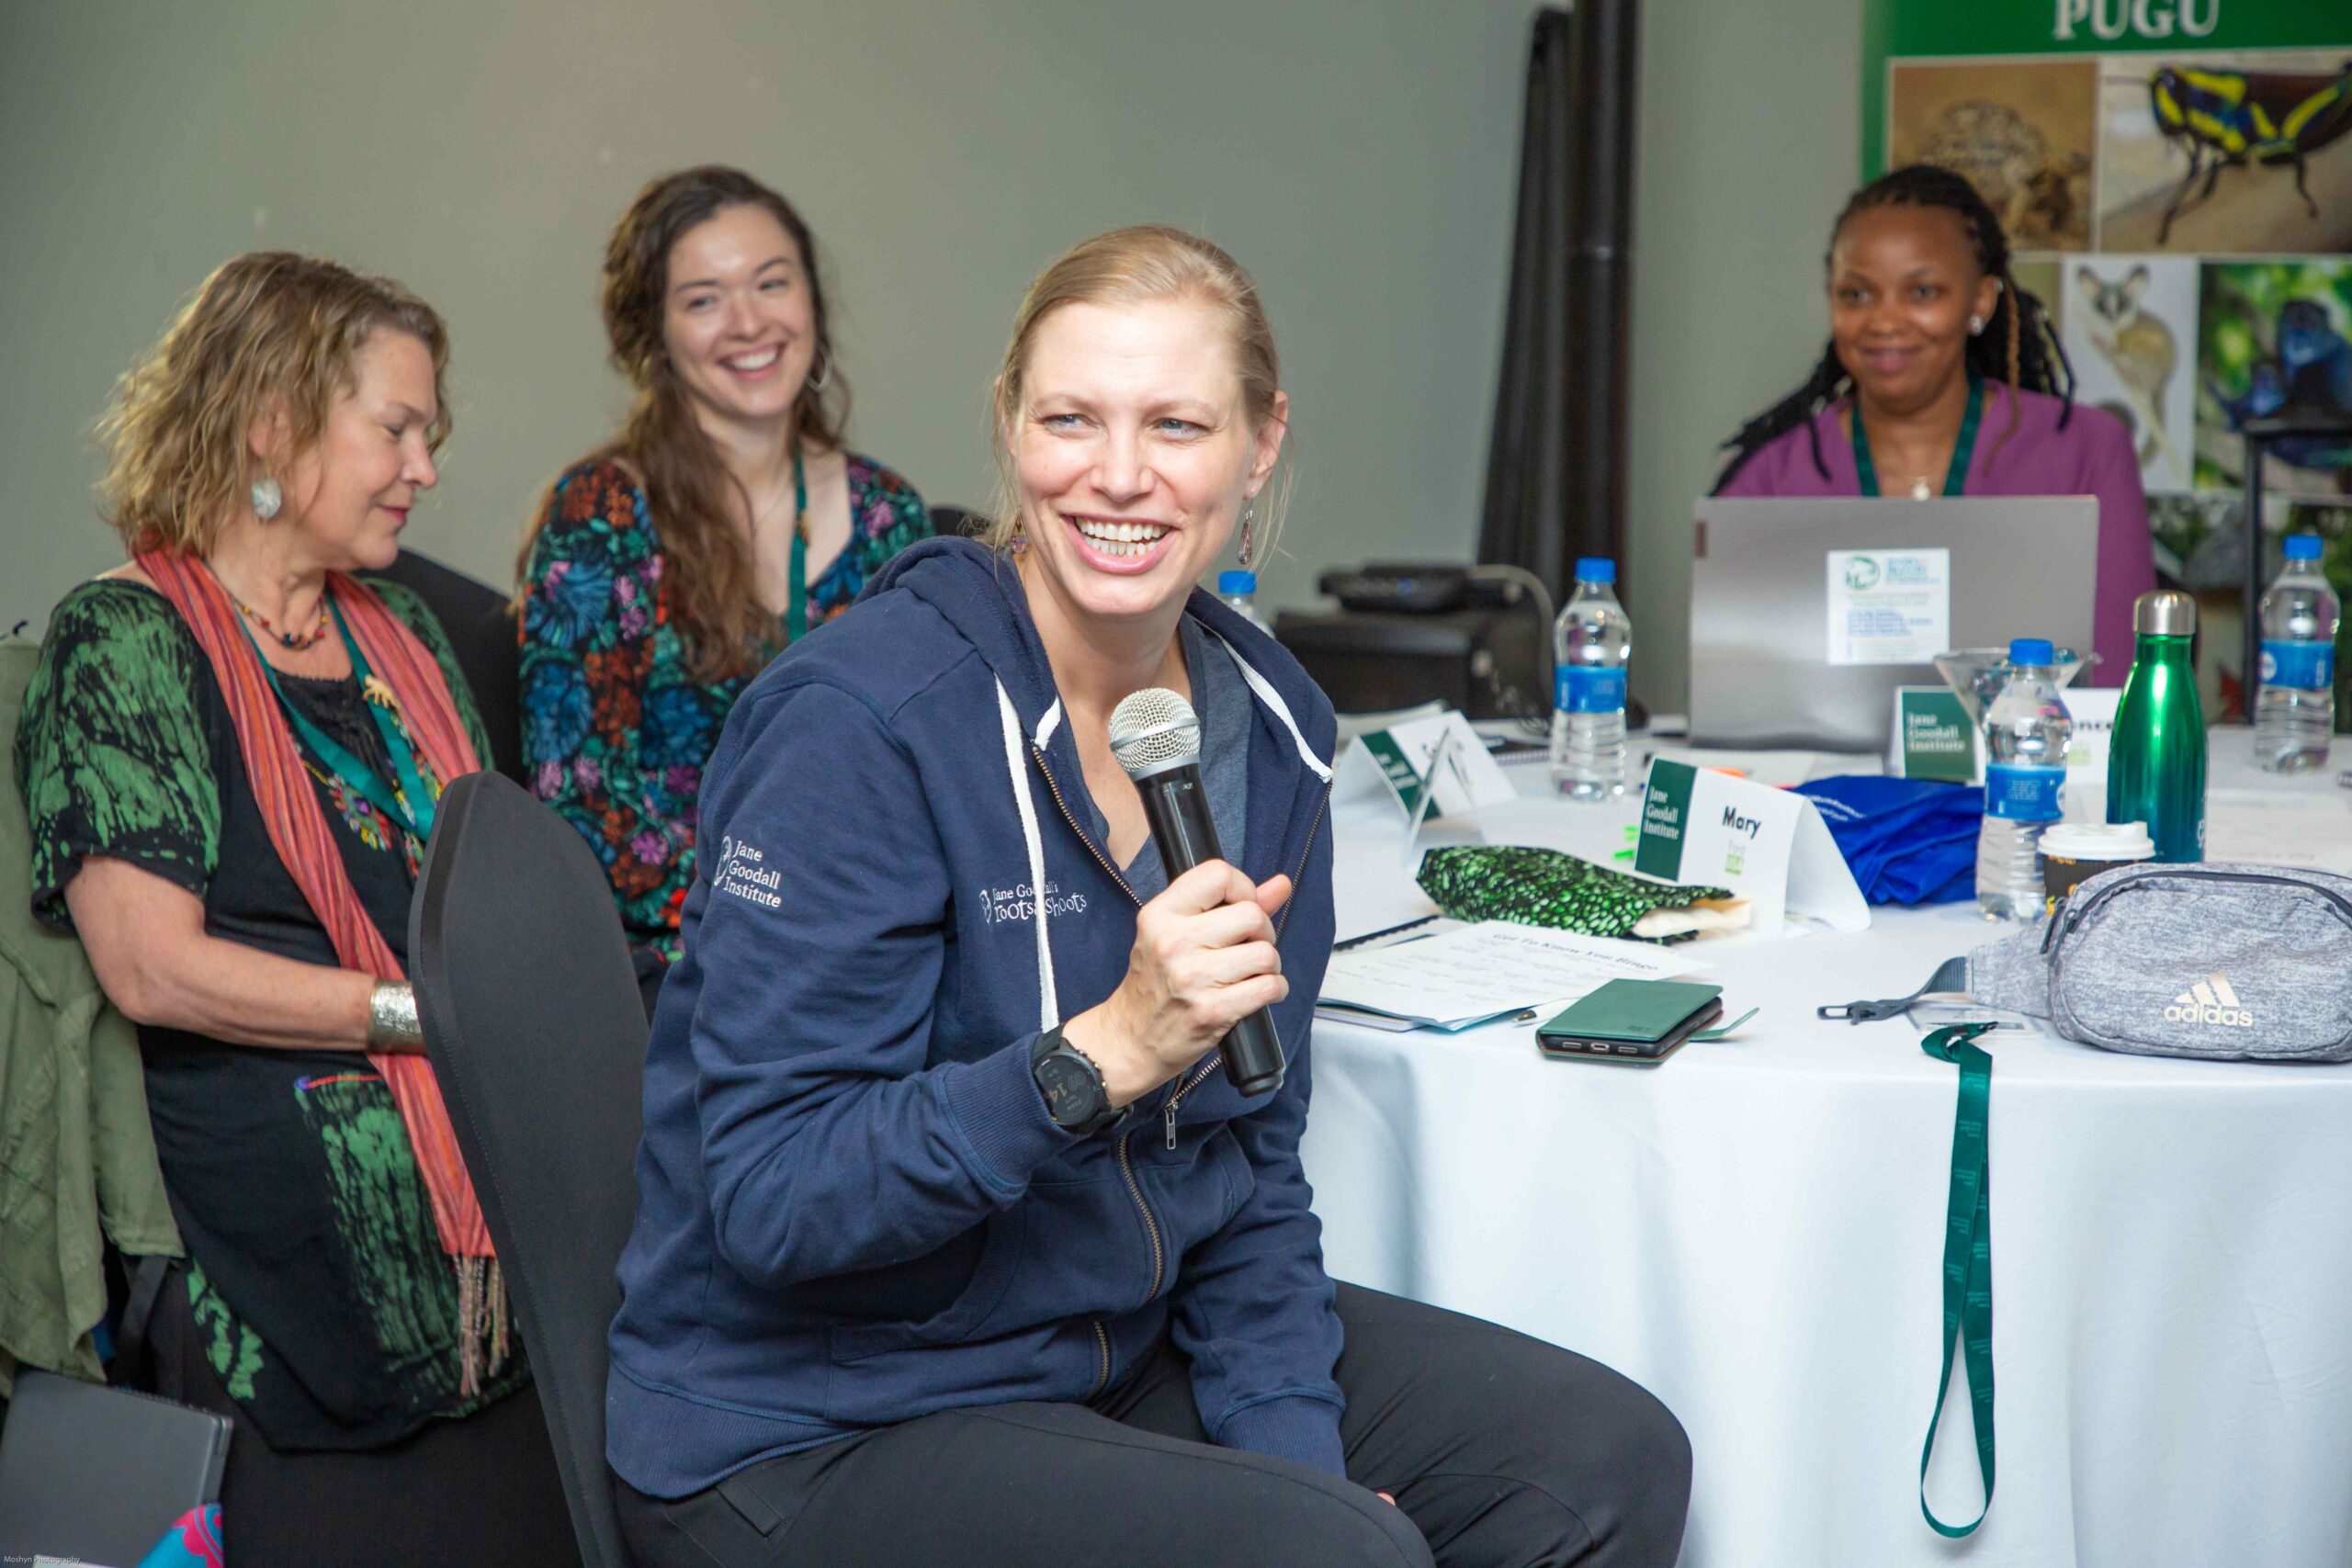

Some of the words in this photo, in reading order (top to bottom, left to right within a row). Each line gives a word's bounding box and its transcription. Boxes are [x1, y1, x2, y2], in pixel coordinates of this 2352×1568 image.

[2052, 0, 2220, 40] PUGU
[1908, 725, 1959, 740] Goodall
[1647, 785, 1668, 804] Jane
[1645, 802, 1679, 824] Goodall
[1722, 806, 1761, 840] Mary
[1643, 818, 1680, 841] Institute
[732, 840, 763, 862] Jane
[729, 860, 781, 890] Goodall
[722, 875, 782, 908] Institute
[992, 887, 1014, 905] Jane
[1015, 880, 1059, 897] Goall's
[2164, 1002, 2254, 1028] adidas
